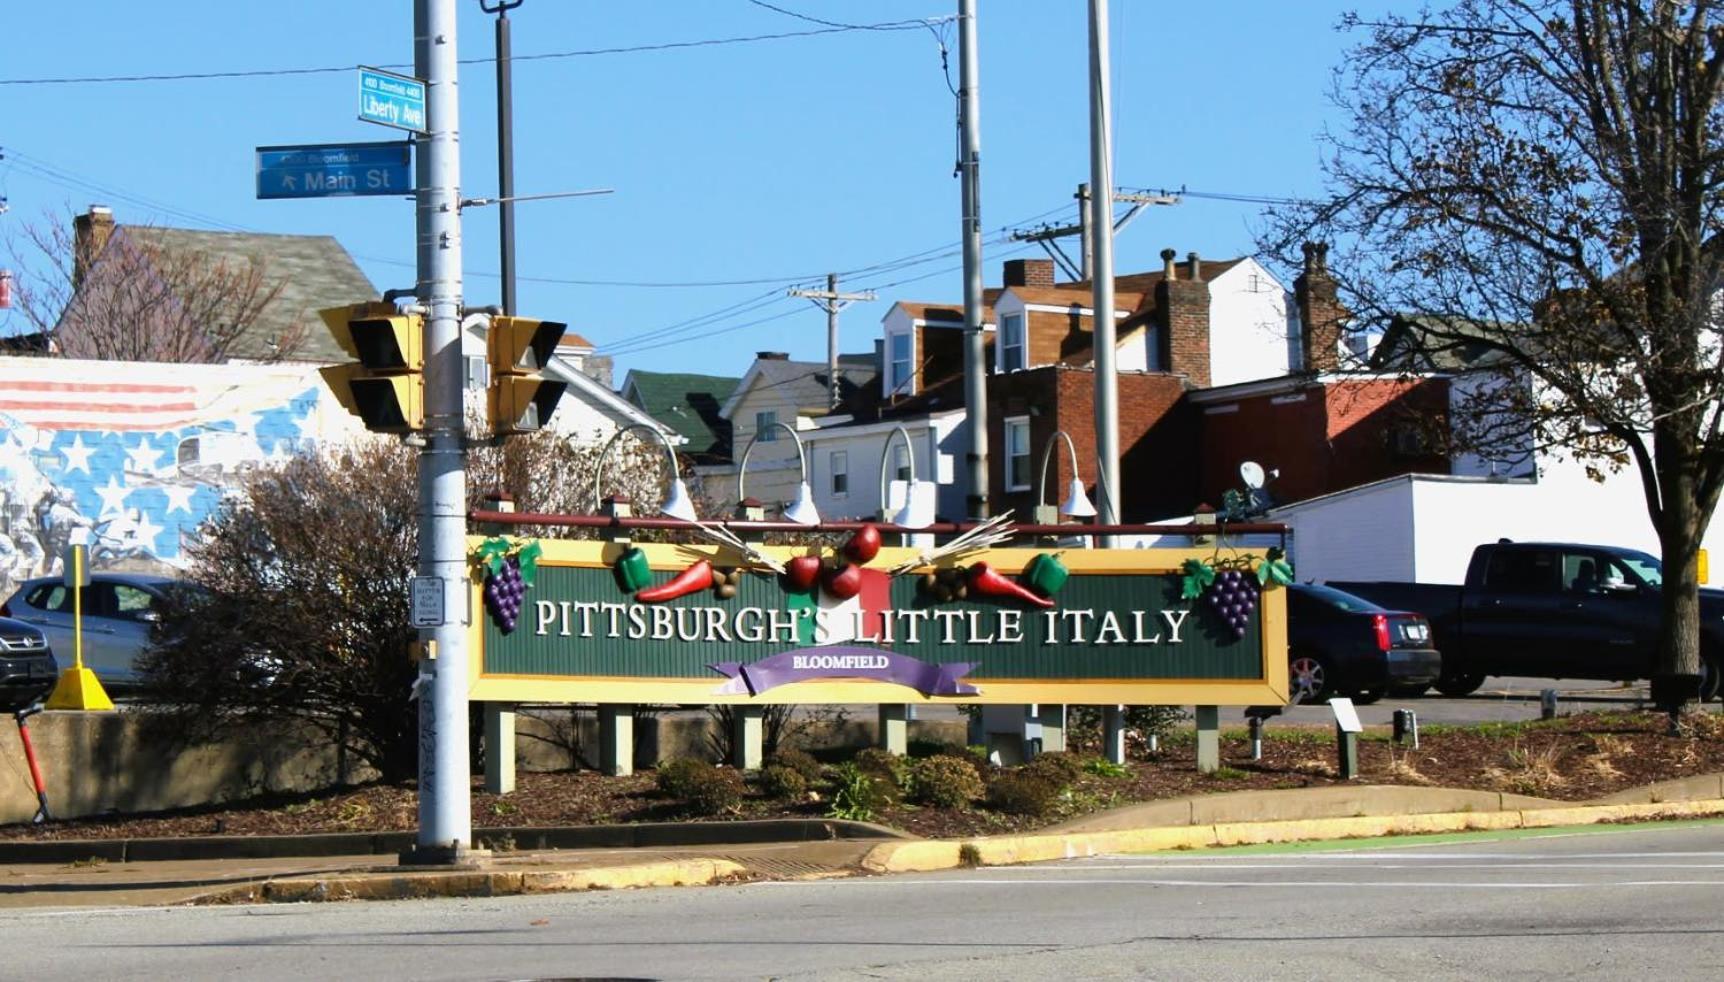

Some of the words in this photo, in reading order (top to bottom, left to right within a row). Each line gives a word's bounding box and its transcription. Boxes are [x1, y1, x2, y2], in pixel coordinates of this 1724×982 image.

[364, 94, 399, 124] Liberty
[403, 102, 422, 126] Ave
[304, 171, 356, 191] Main
[367, 168, 390, 188] St
[535, 600, 831, 643] PITTSBURGH'S
[852, 608, 1024, 644] LITTLE
[1044, 609, 1190, 644] ITALY
[793, 655, 890, 669] BLOOMFIELD
